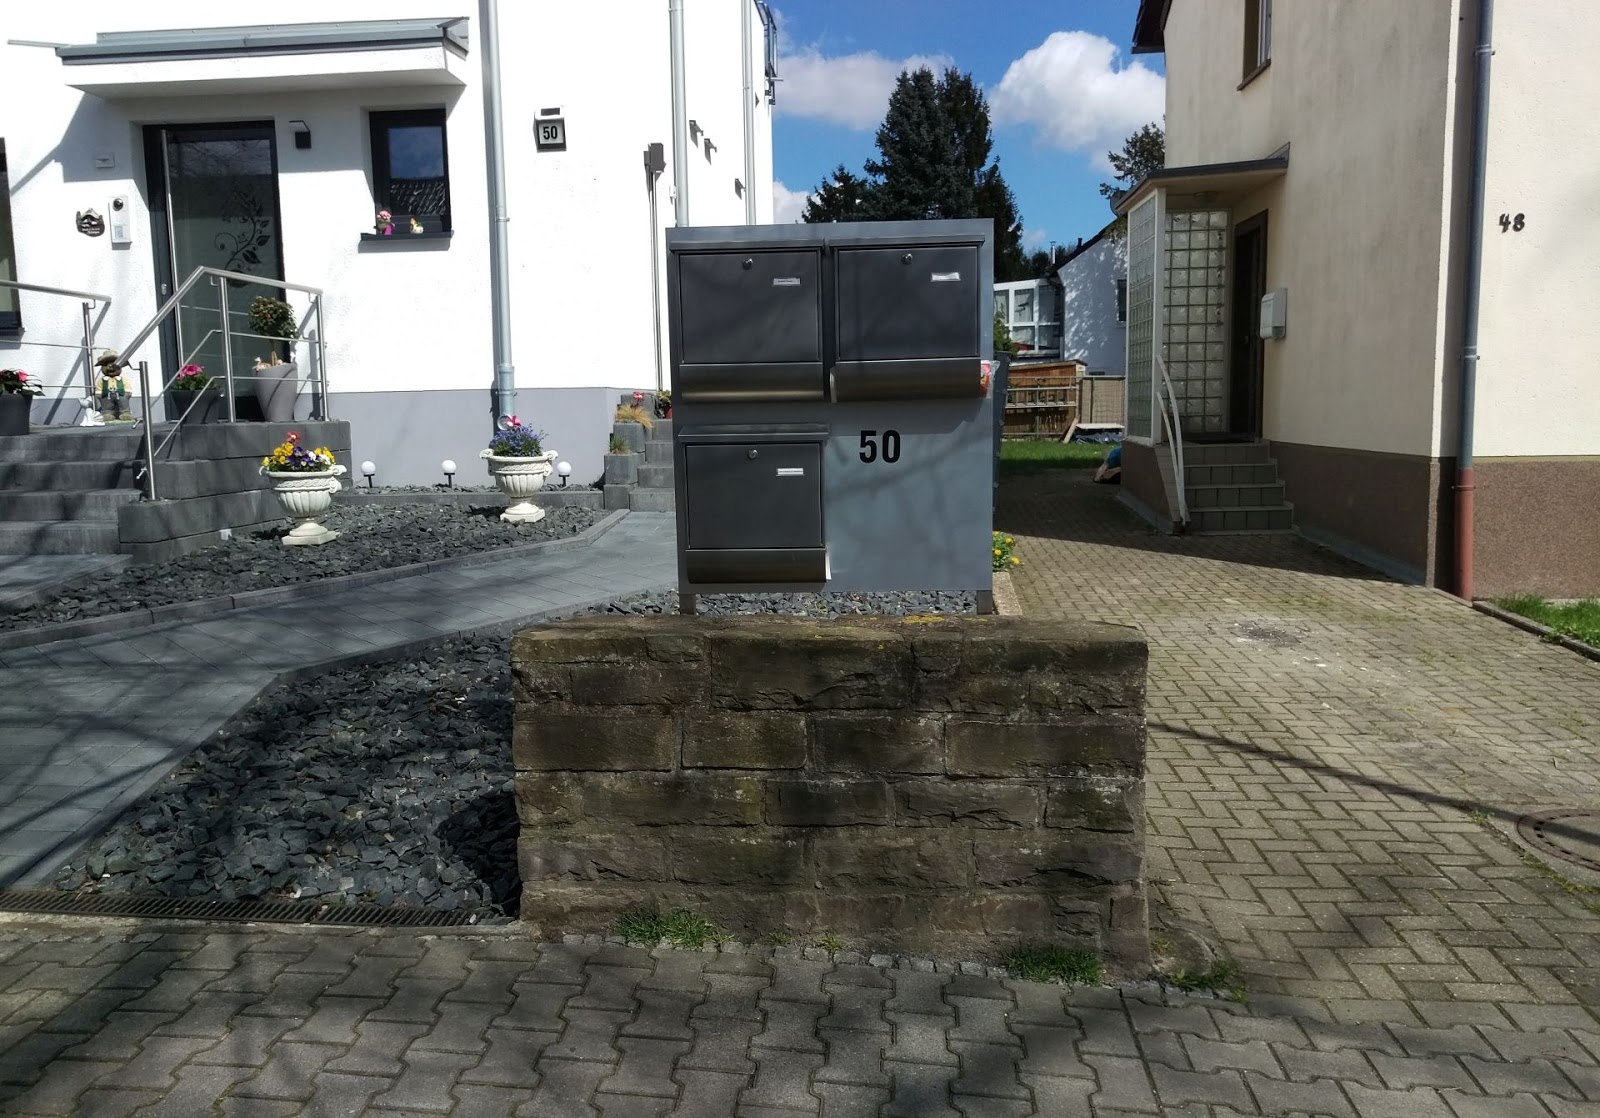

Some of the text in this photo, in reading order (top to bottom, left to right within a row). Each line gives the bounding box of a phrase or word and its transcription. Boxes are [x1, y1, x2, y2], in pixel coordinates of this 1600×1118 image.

[543, 126, 558, 140] 50
[1499, 212, 1525, 233] 48
[859, 430, 901, 464] 50
